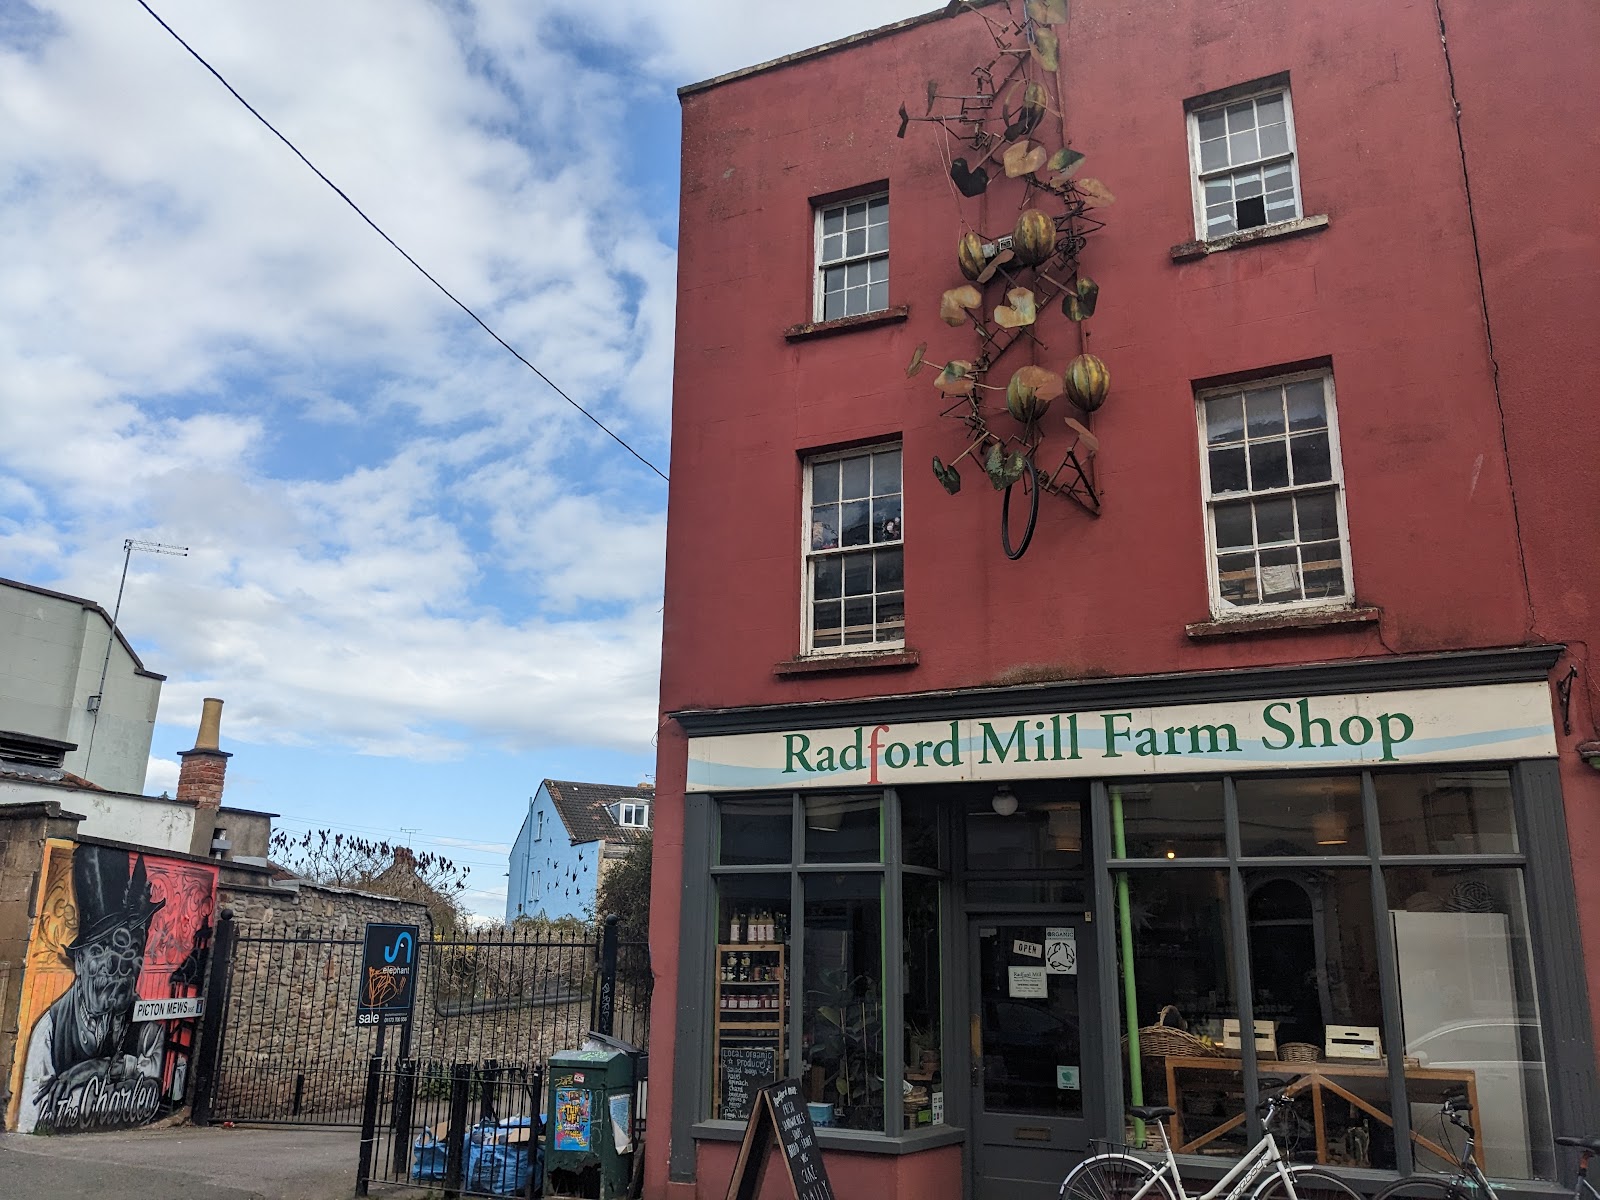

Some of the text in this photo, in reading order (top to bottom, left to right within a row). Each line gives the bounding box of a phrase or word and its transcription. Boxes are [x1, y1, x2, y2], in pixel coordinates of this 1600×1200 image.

[782, 698, 1414, 784] Radford Mill Farm Shop
[1018, 943, 1037, 955] OPEN
[383, 966, 410, 976] elephant
[137, 1003, 165, 1016] PICTON
[167, 1001, 188, 1015] MEWS
[358, 1011, 380, 1024] sale
[54, 1097, 79, 1128] The
